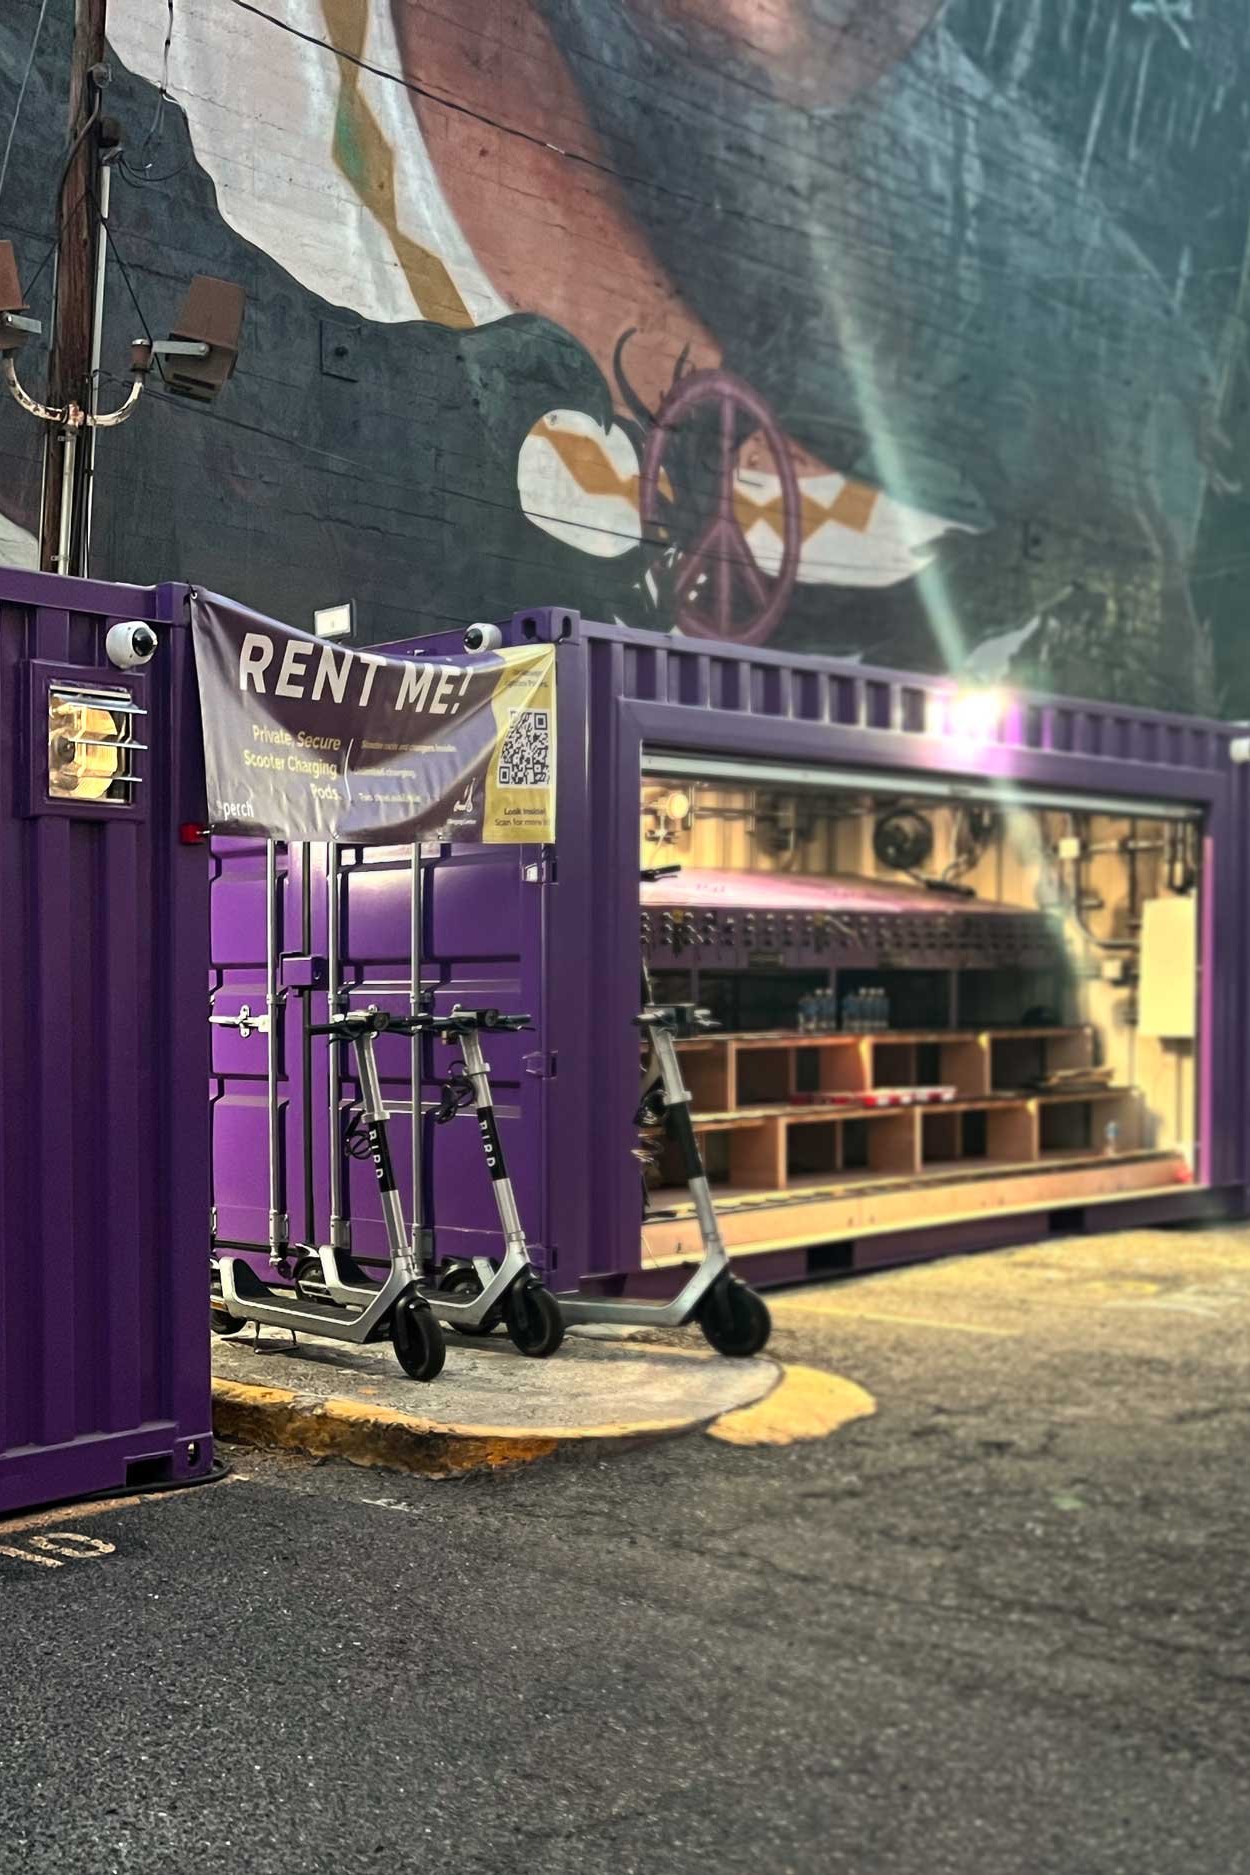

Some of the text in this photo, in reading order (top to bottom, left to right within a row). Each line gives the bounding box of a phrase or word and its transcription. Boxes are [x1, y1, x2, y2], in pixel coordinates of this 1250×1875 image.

[239, 632, 474, 715] RENT ME!
[297, 731, 341, 750] Secure
[243, 748, 285, 769] Scooter
[287, 755, 338, 780] Charging
[223, 800, 254, 821] perch
[369, 1129, 384, 1179] BIRD
[479, 1119, 496, 1167] BIRD
